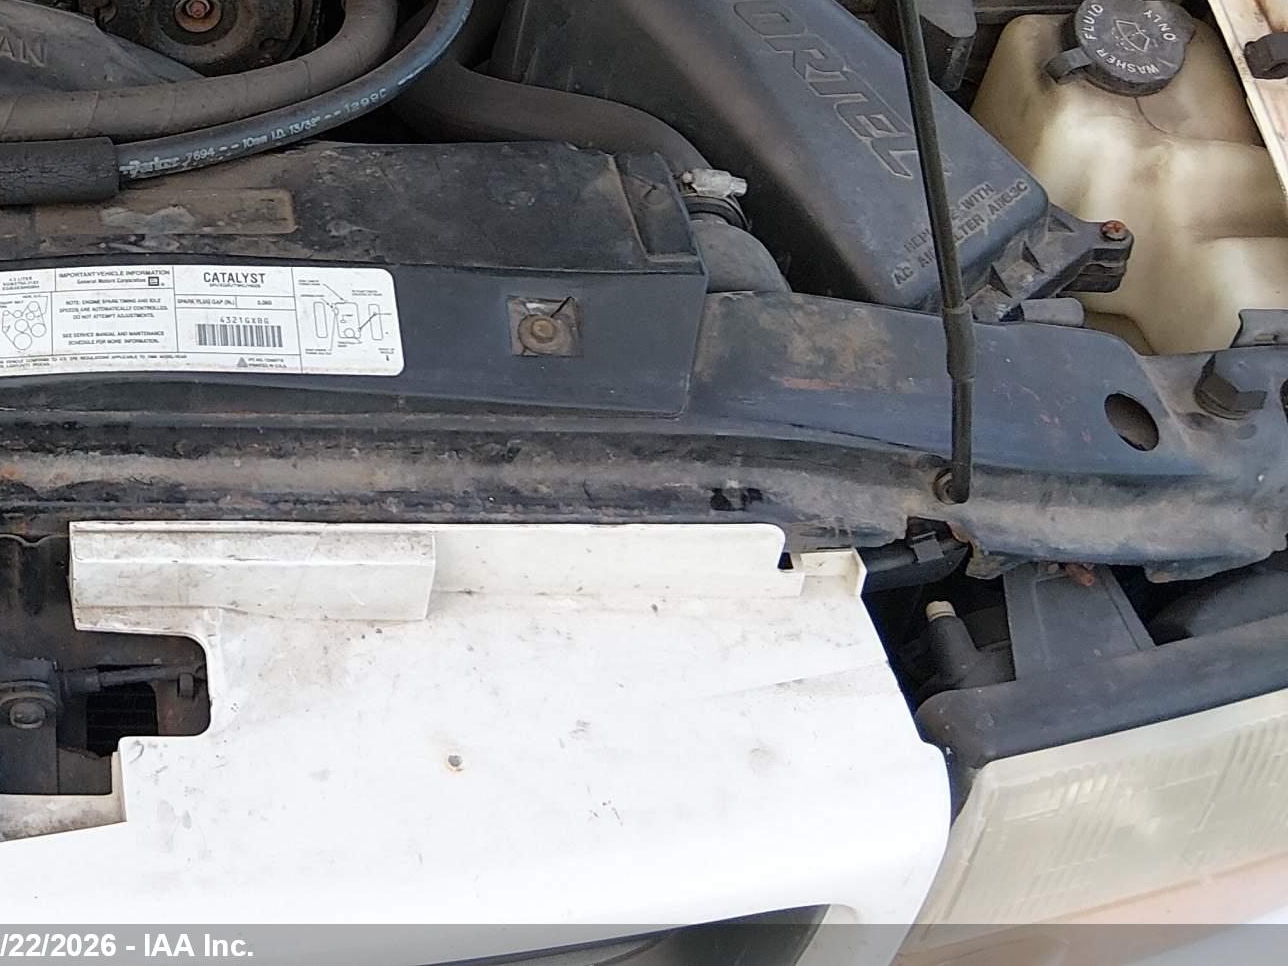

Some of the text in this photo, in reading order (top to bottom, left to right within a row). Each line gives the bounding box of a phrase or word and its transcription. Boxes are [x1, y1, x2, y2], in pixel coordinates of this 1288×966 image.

[1081, 3, 1177, 75] WASHER FLUID ONLY
[203, 272, 266, 284] CATALYST
